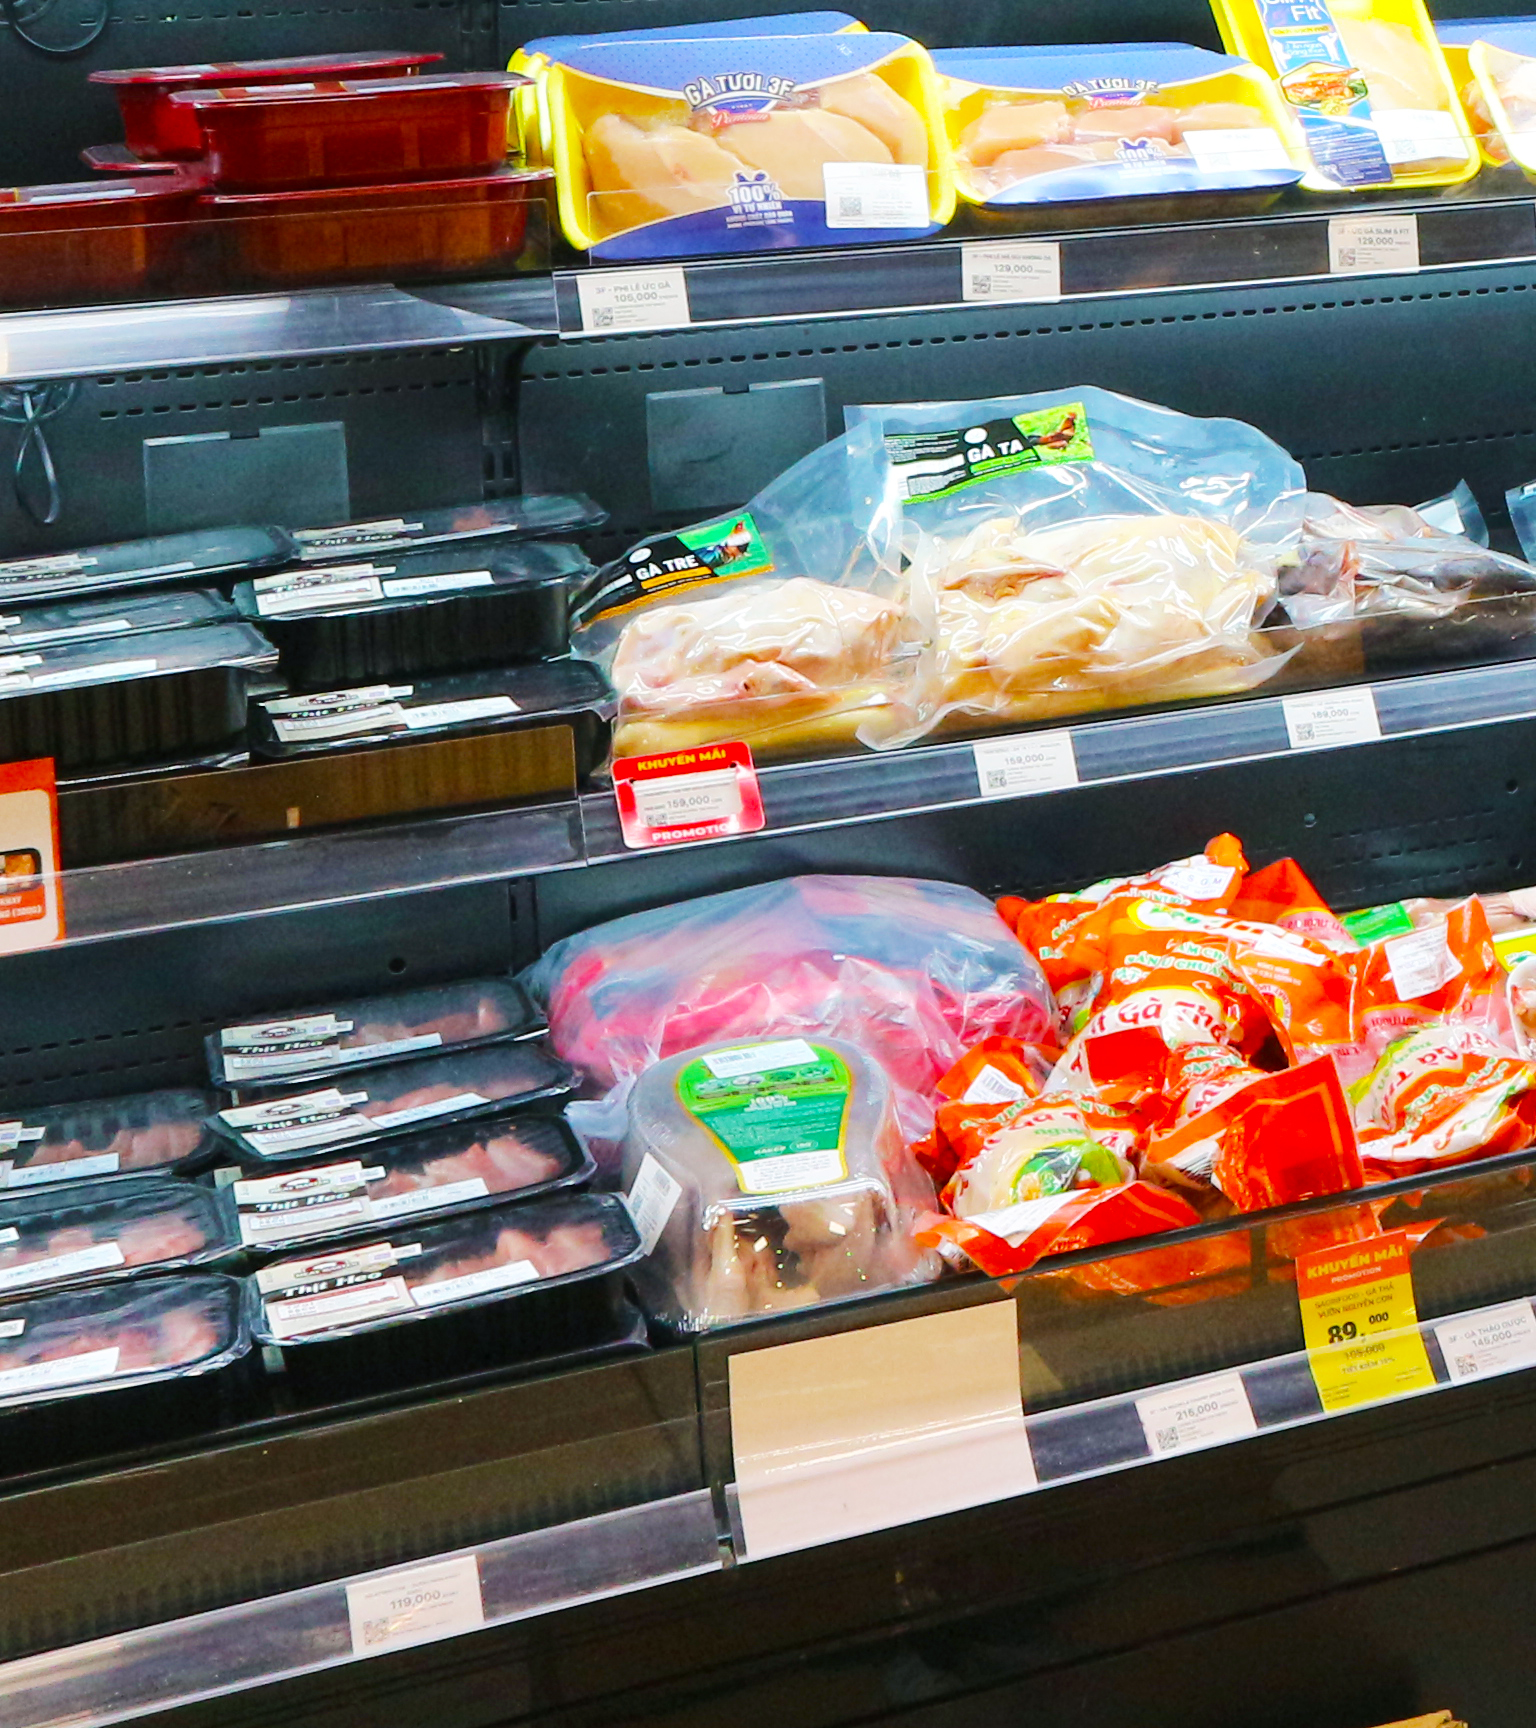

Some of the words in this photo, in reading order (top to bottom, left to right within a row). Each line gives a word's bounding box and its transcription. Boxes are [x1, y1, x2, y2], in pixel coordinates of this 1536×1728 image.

[1291, 5, 1323, 22] Fit
[684, 77, 715, 110] GÀ
[714, 72, 763, 93] TƯƠI
[768, 76, 794, 97] 3F
[728, 183, 782, 204] 100%
[967, 442, 996, 463] GÀ
[998, 438, 1024, 456] TA
[637, 564, 664, 582] GÀ
[664, 555, 702, 575] TRE
[637, 750, 696, 771] KHUYẾN
[238, 1043, 277, 1055] Thịt
[281, 1039, 324, 1052] Heo
[256, 1200, 301, 1213] Thịt
[305, 1191, 351, 1207] Heo
[1307, 1251, 1370, 1279] KHUYẾN
[1374, 1242, 1403, 1263] MÃI
[282, 1283, 328, 1299] Thịt
[333, 1270, 384, 1287] Heo
[1369, 1311, 1389, 1325] 000
